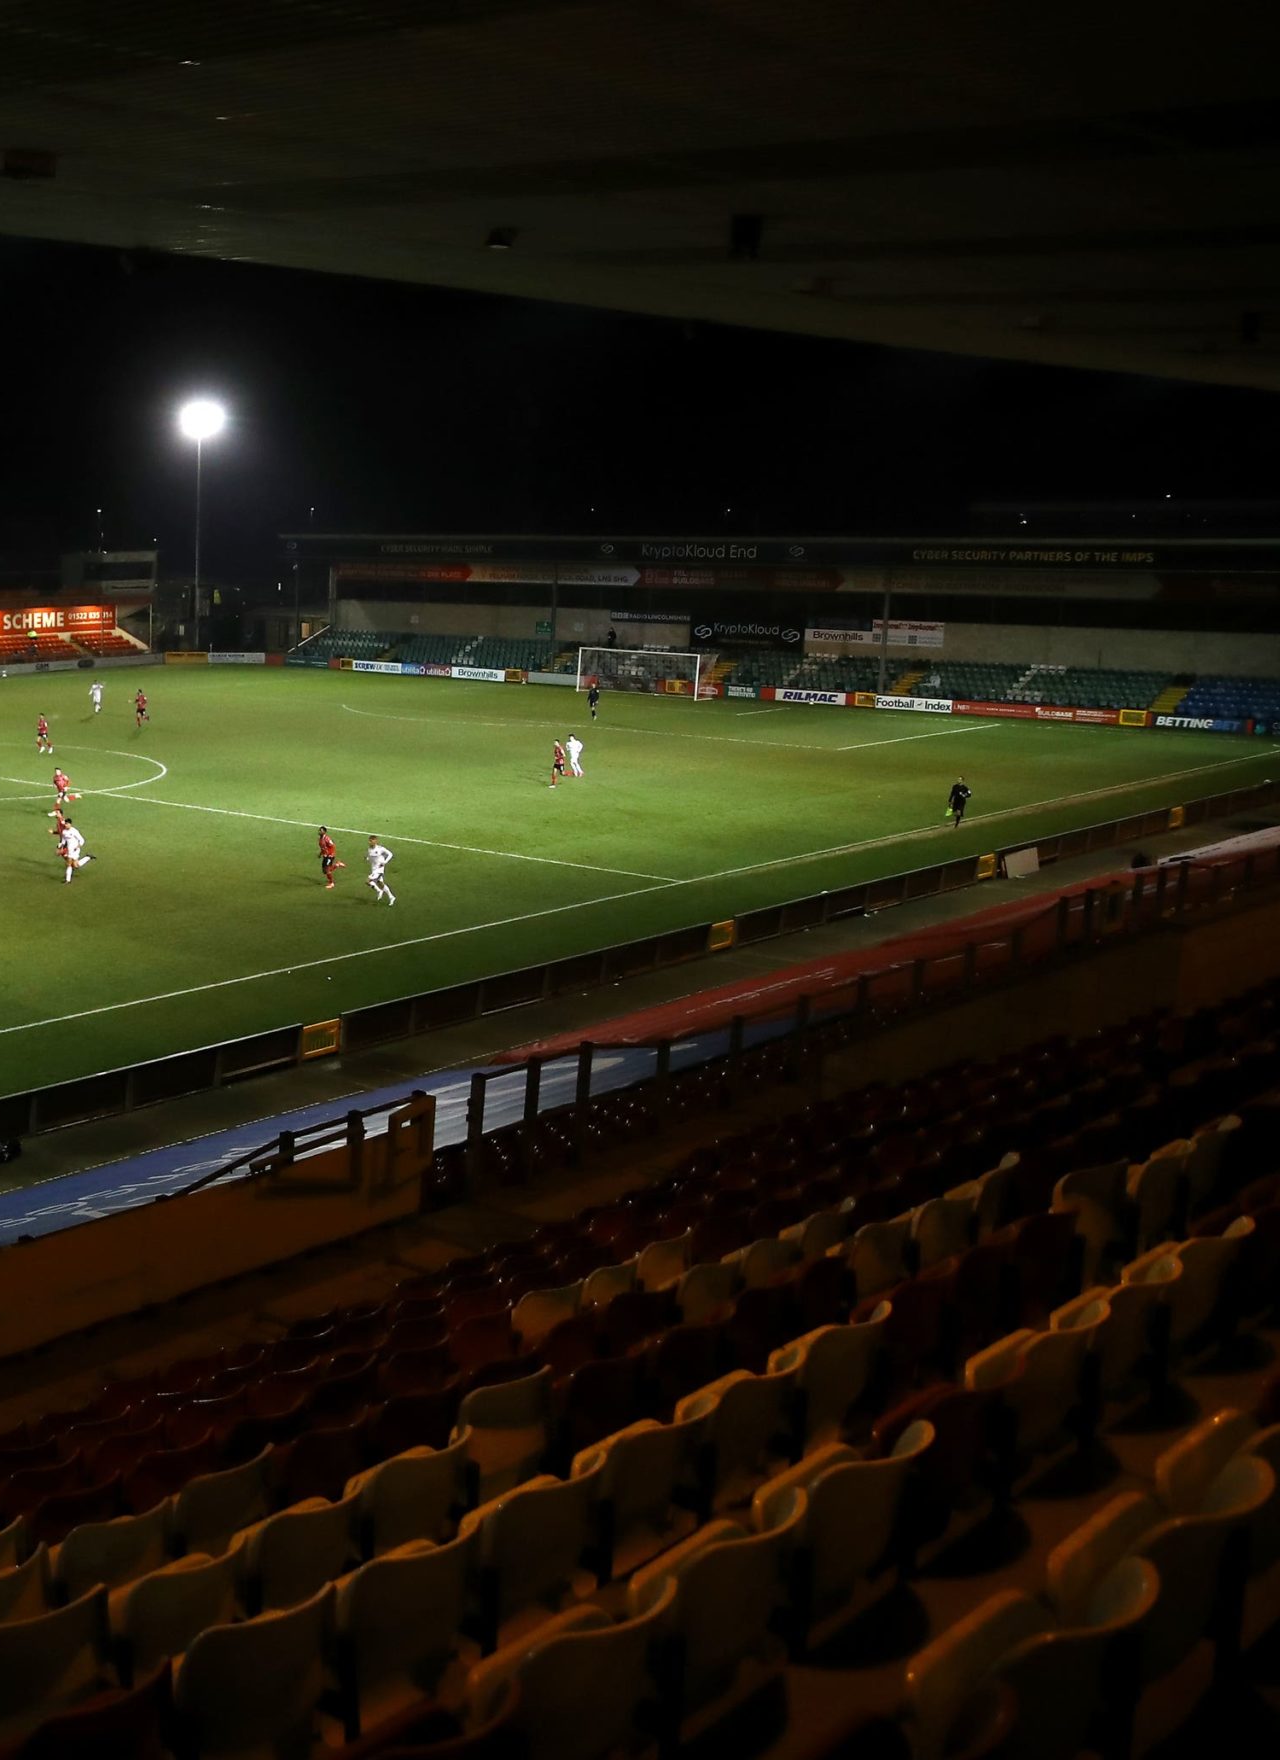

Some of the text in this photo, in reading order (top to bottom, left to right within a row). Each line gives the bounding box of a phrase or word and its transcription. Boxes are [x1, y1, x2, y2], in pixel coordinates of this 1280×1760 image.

[640, 543, 758, 561] KryptoKloud End
[912, 549, 1154, 564] CYBER SECURITY PARTNERS OF THE IMPS
[3, 611, 65, 630] SCHEME
[713, 622, 780, 639] KryptoKloud
[812, 630, 864, 642] Brownhills
[426, 667, 445, 677] utilita
[457, 668, 498, 681] Brownhills
[782, 691, 838, 703] RILMAC
[876, 697, 952, 712] Football Index
[1155, 715, 1241, 732] BETTINGBET
